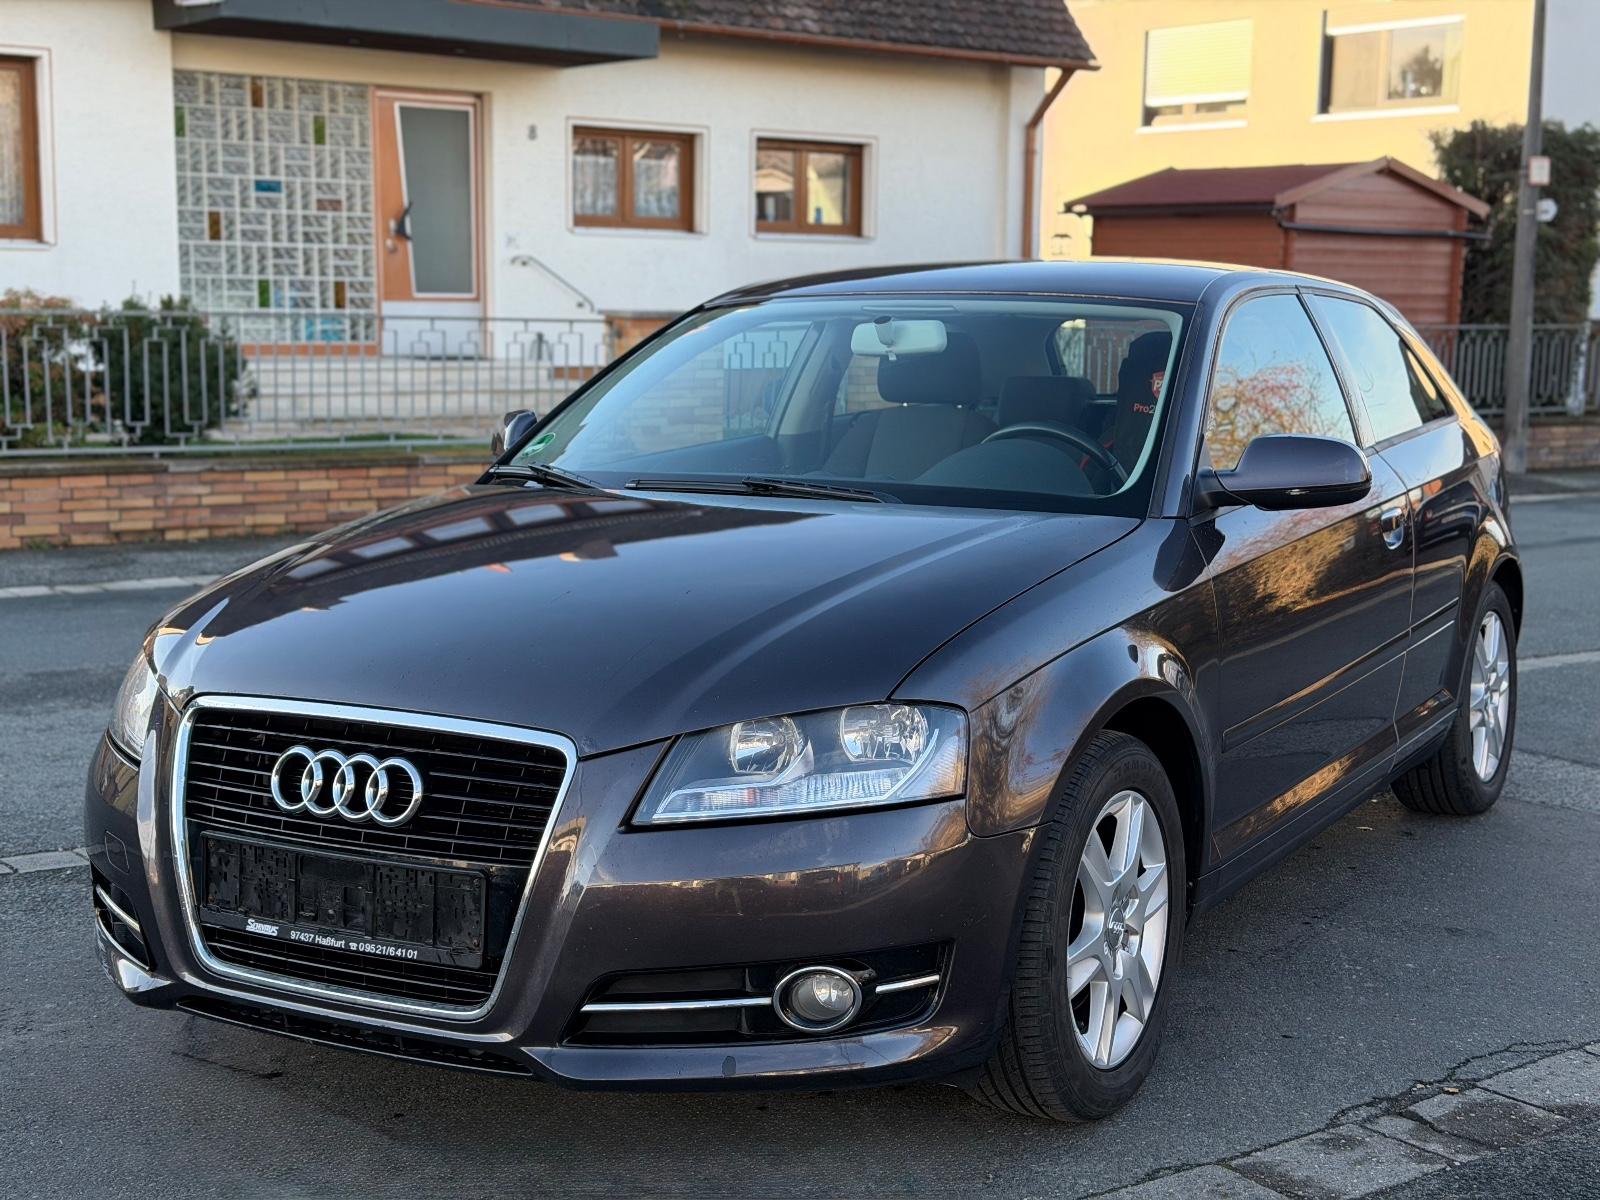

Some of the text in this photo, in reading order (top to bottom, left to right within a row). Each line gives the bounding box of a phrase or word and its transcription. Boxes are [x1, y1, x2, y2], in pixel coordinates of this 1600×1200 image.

[290, 930, 314, 943] 97437
[315, 935, 346, 949] Haßfurt
[358, 942, 418, 960] 09521/64101
